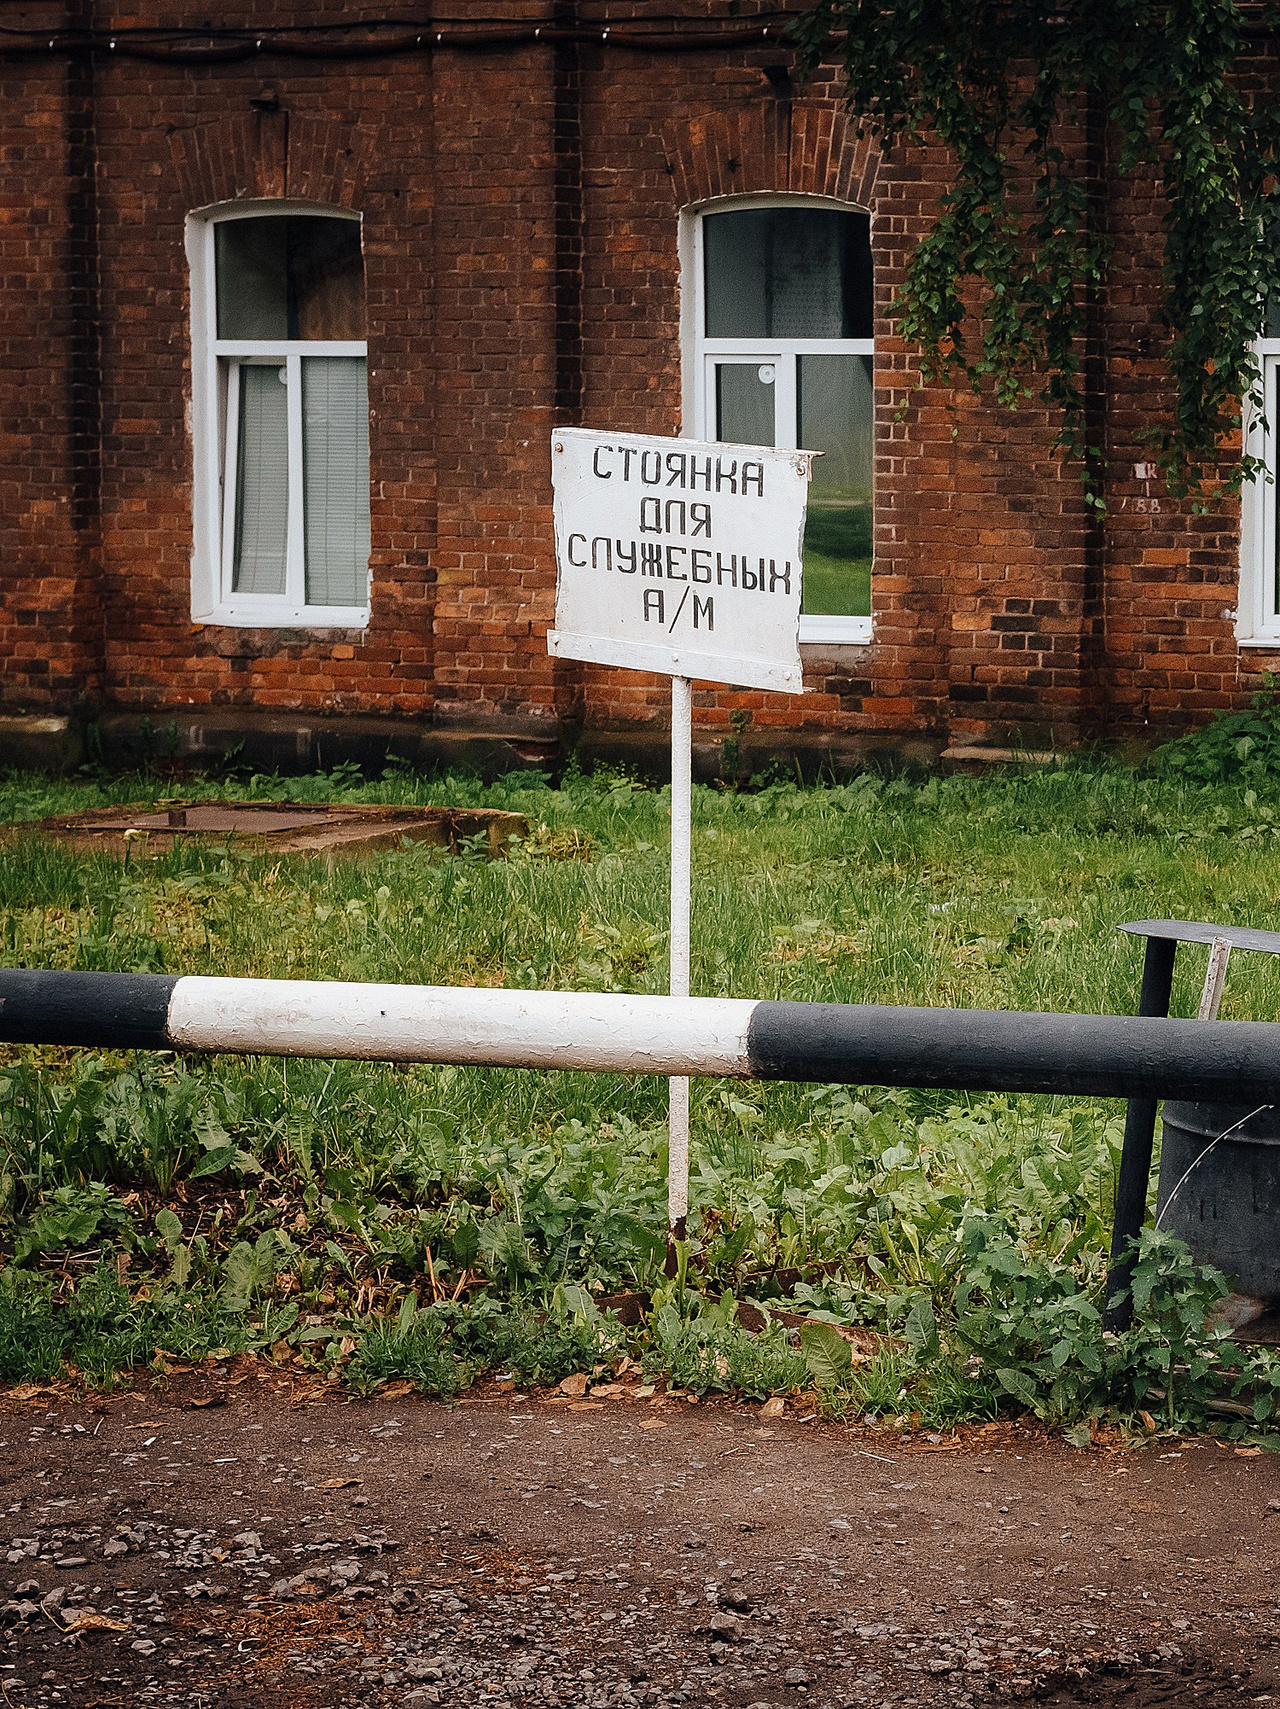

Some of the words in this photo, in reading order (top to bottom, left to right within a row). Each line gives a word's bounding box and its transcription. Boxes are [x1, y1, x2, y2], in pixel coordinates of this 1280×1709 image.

[593, 445, 764, 497] СТОЯНКА
[639, 497, 712, 538] ДЛЯ
[568, 533, 791, 595] СЛУЖЕБНЫХ
[643, 585, 714, 632] А/М
